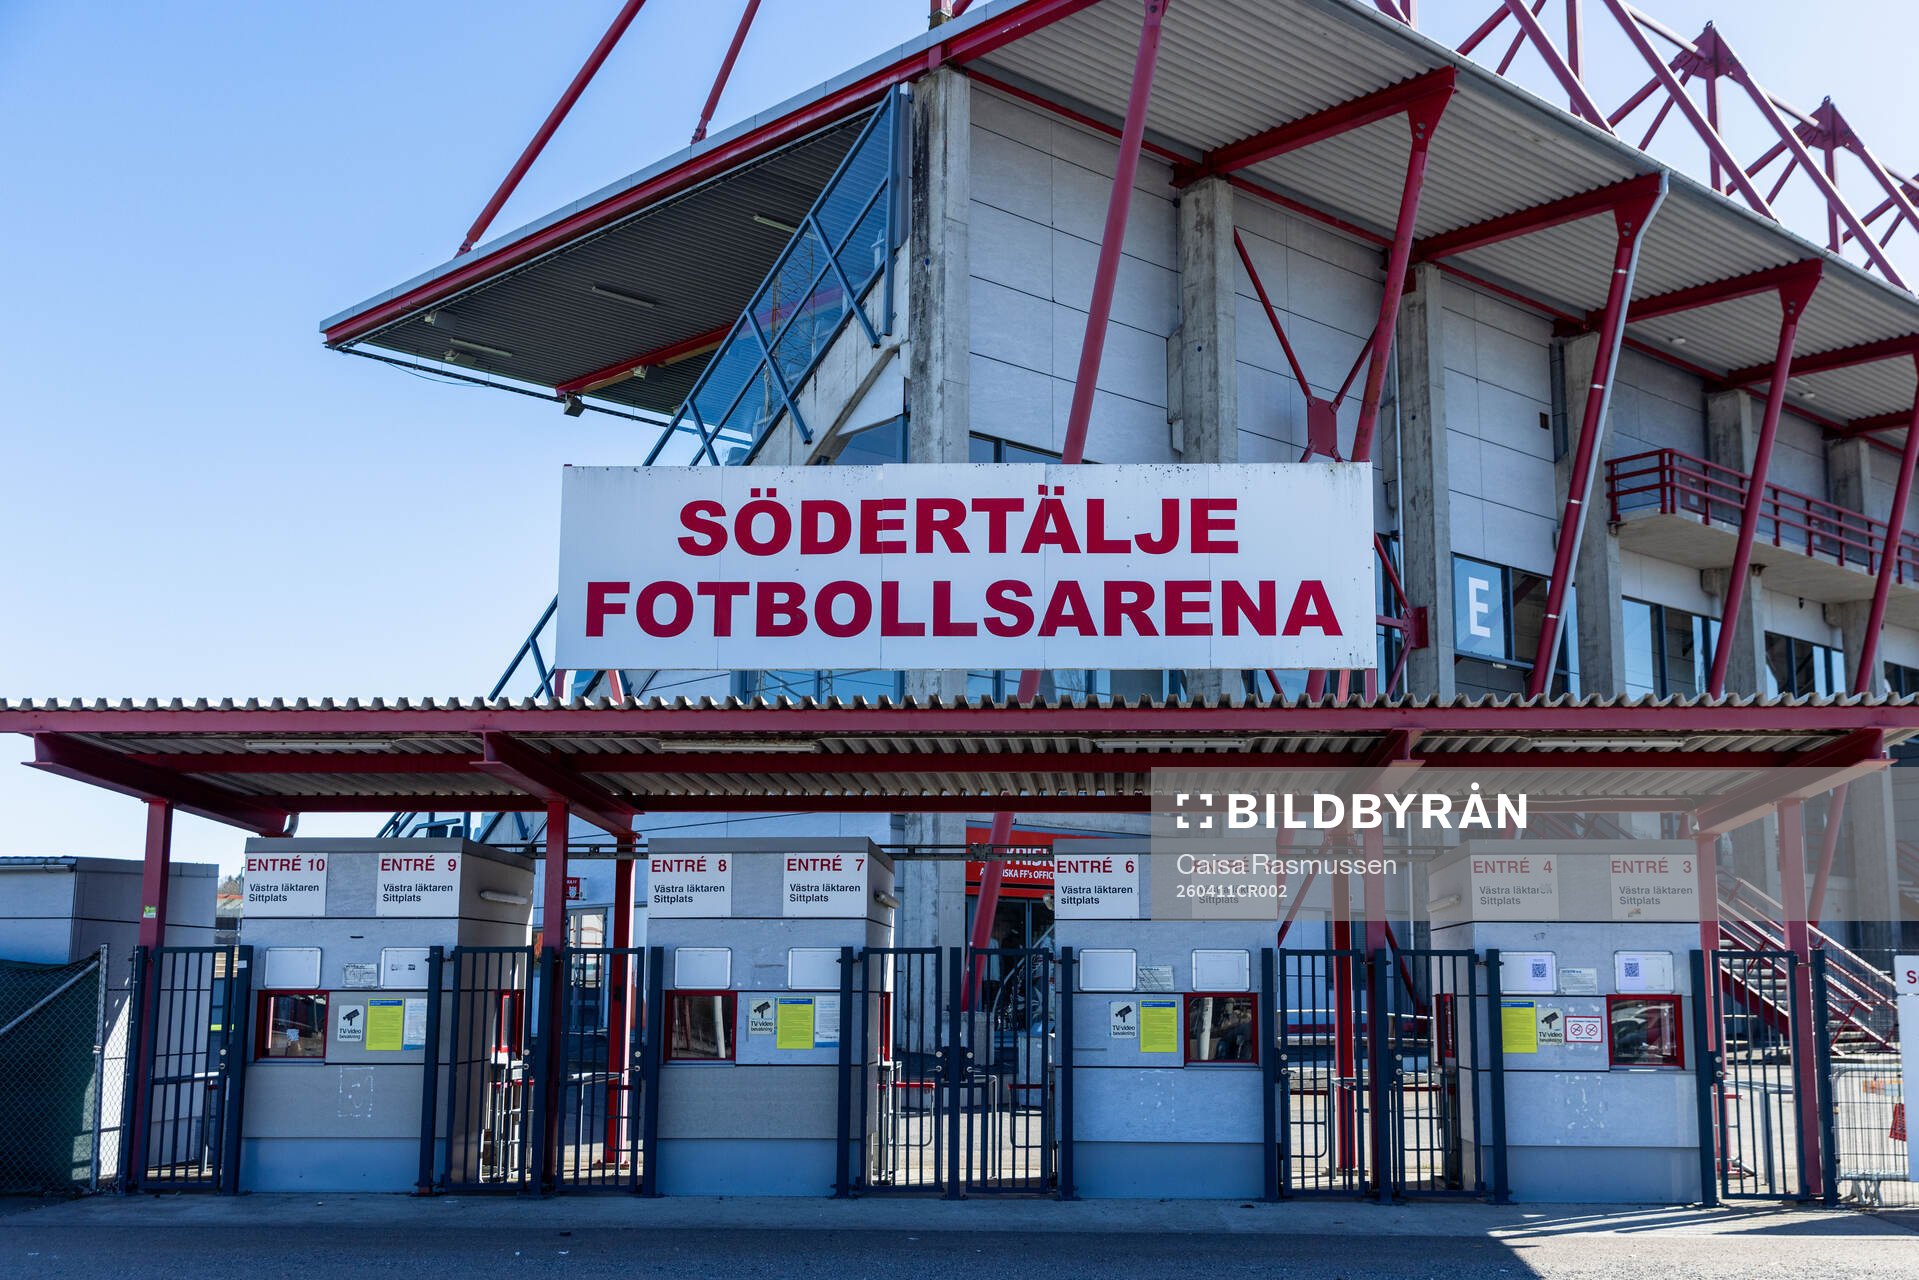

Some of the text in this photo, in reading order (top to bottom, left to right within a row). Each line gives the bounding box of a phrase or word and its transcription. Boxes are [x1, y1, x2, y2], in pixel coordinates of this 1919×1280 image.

[677, 485, 1240, 557] SÖDERTÄLJE
[585, 579, 1344, 638] FOTBOLLSARENA
[1468, 576, 1490, 638] E
[247, 855, 325, 872] ENTRÉ 10
[381, 855, 457, 872] ENTRÉ 9
[651, 856, 728, 873] ENTRÉ 8
[787, 855, 865, 872] ENTRÉ 7
[1057, 856, 1135, 873] ENTRÉ 6
[1473, 857, 1553, 873] ENTRÉ 4
[1611, 857, 1692, 873] ENTRÉ 3
[249, 883, 319, 892] Västra läktaren
[383, 883, 453, 892] Västra läktaren
[654, 884, 725, 893] Västra läktaren
[789, 883, 861, 892] Västra läktaren
[1061, 885, 1133, 894] Västra läktaren
[1479, 886, 1511, 895] Västra
[1619, 886, 1693, 895] Västra läktaren
[249, 893, 288, 904] Sittplats
[382, 893, 421, 904] Sittplats
[654, 894, 693, 905] Sittplats
[789, 893, 829, 904] Sittplats
[1060, 896, 1100, 907] sittplats
[1480, 897, 1521, 908] Sittplats
[1619, 897, 1661, 908] Sittplats
[1906, 970, 1919, 984] S
